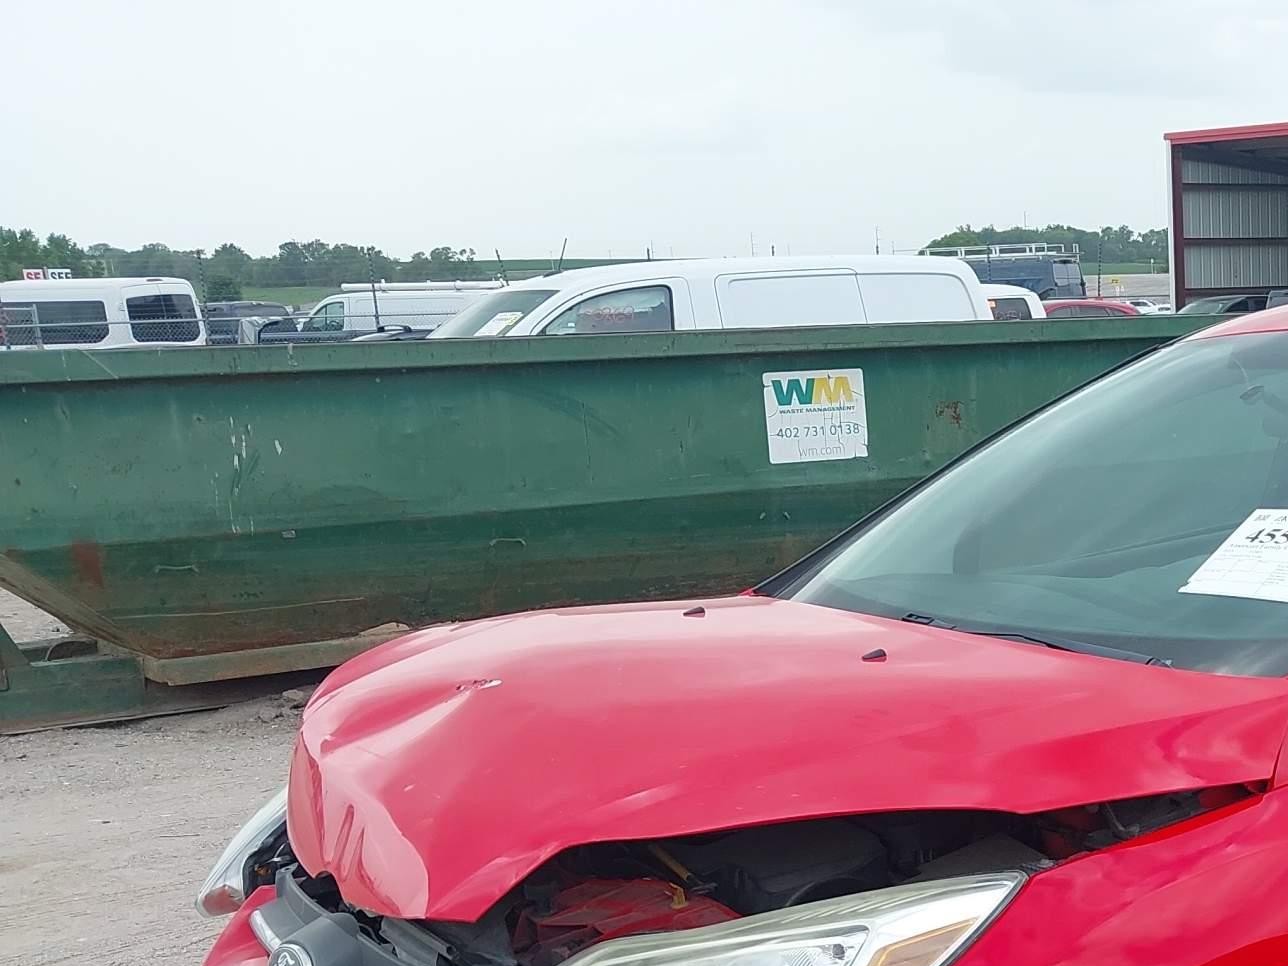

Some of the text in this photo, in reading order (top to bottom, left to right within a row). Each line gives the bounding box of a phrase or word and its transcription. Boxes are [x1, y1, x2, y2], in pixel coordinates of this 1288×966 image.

[771, 376, 854, 406] WM
[805, 405, 856, 413] MANAGEMENT
[776, 423, 860, 439] 402 731 0138
[799, 446, 842, 457] wm.com
